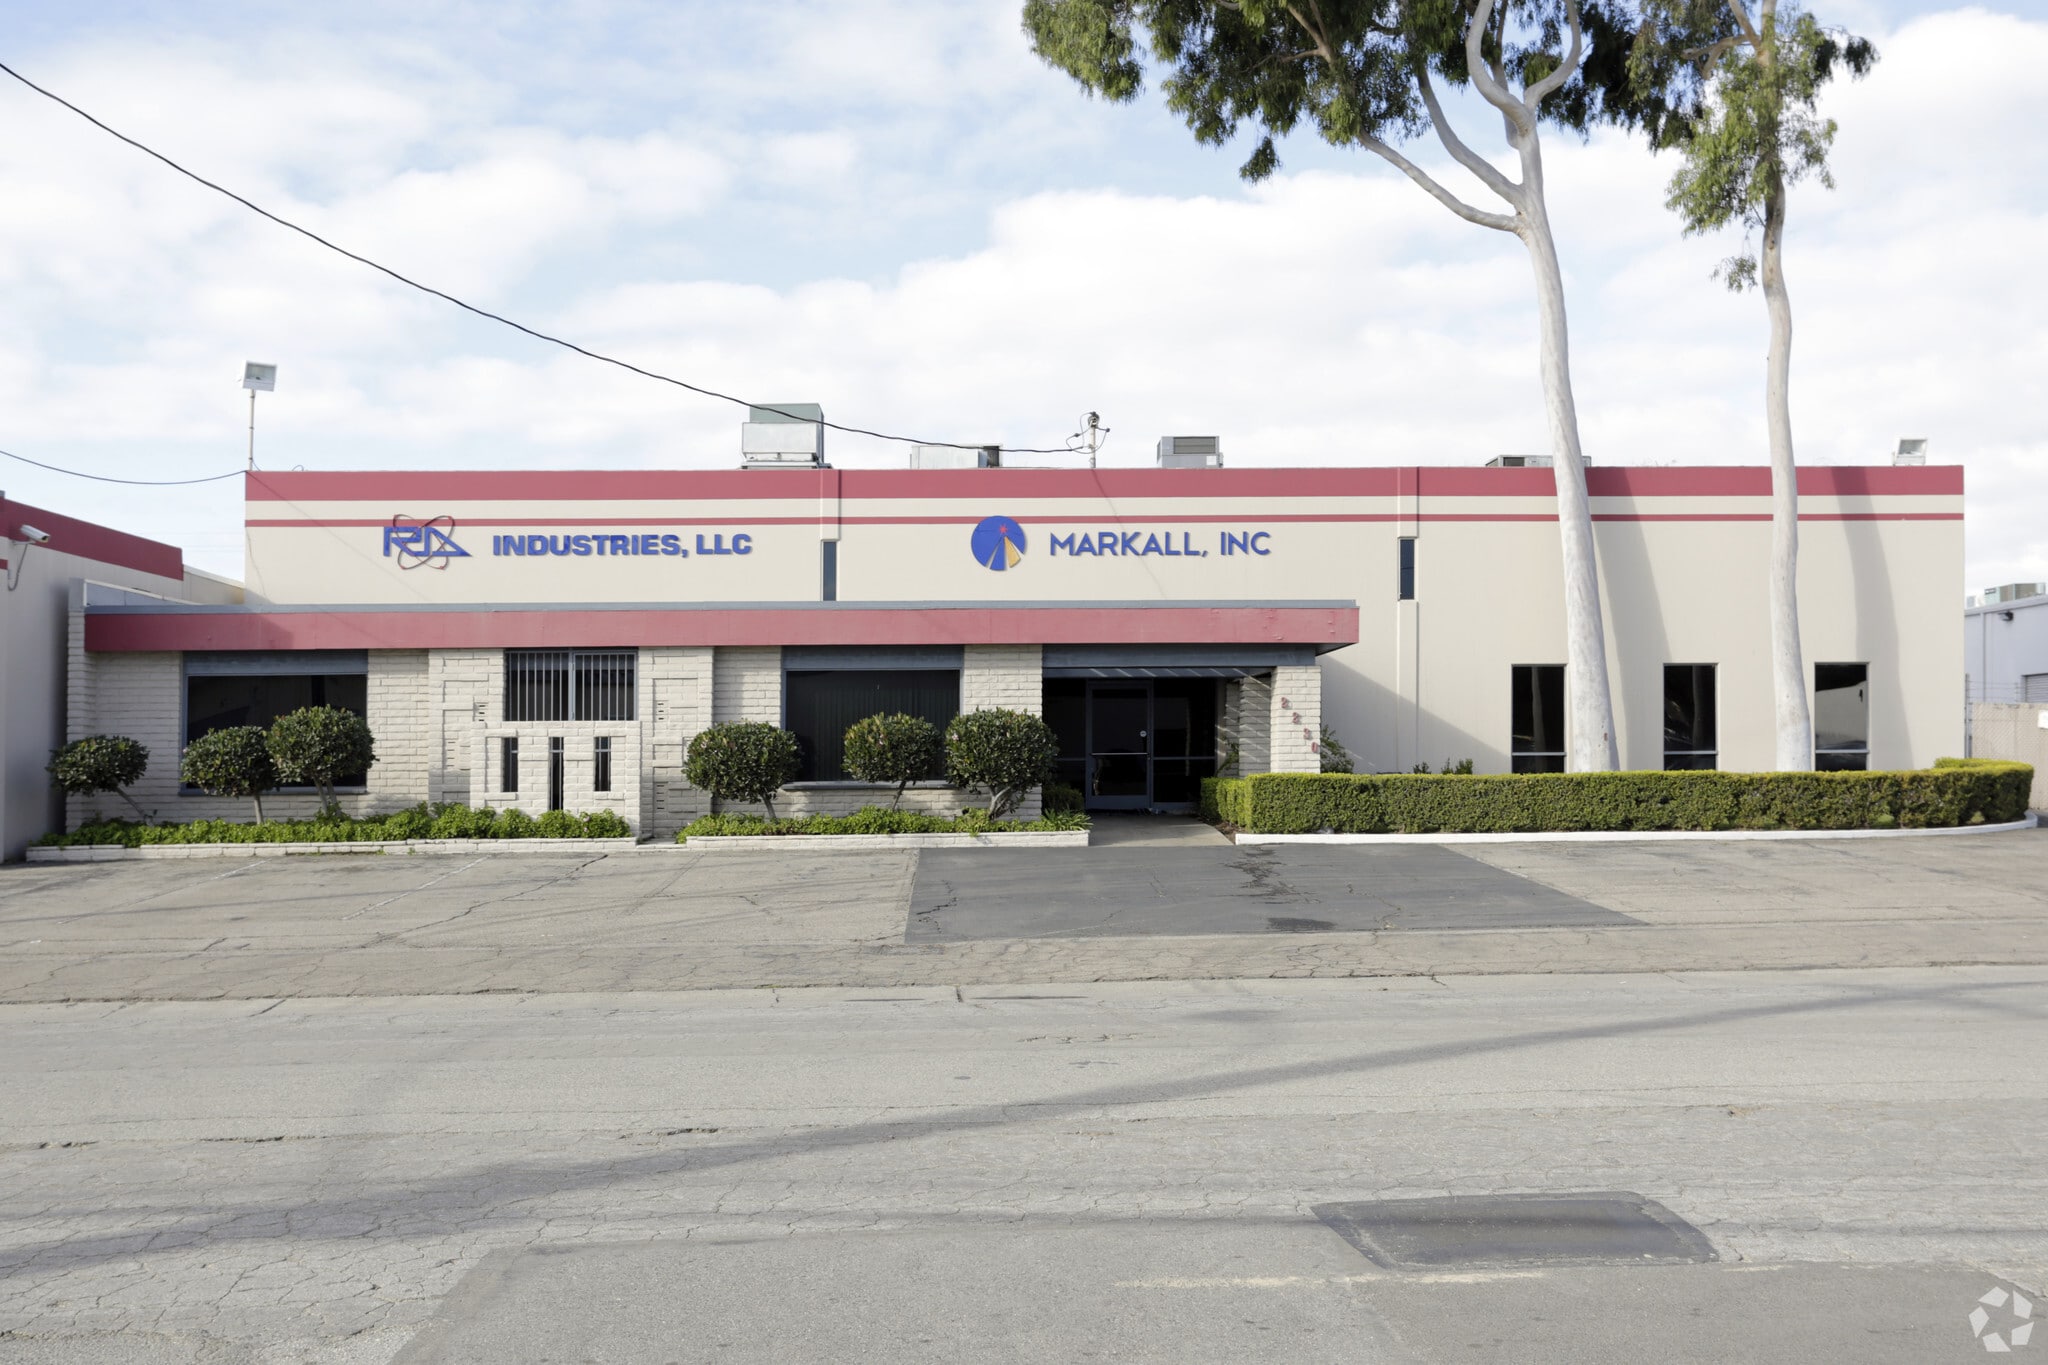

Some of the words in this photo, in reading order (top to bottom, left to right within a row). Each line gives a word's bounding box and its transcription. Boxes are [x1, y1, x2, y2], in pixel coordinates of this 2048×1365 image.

[492, 533, 690, 558] INDUSTRIES,
[695, 533, 753, 555] LLC
[1050, 531, 1208, 557] MARKALL,
[1220, 531, 1271, 555] INC
